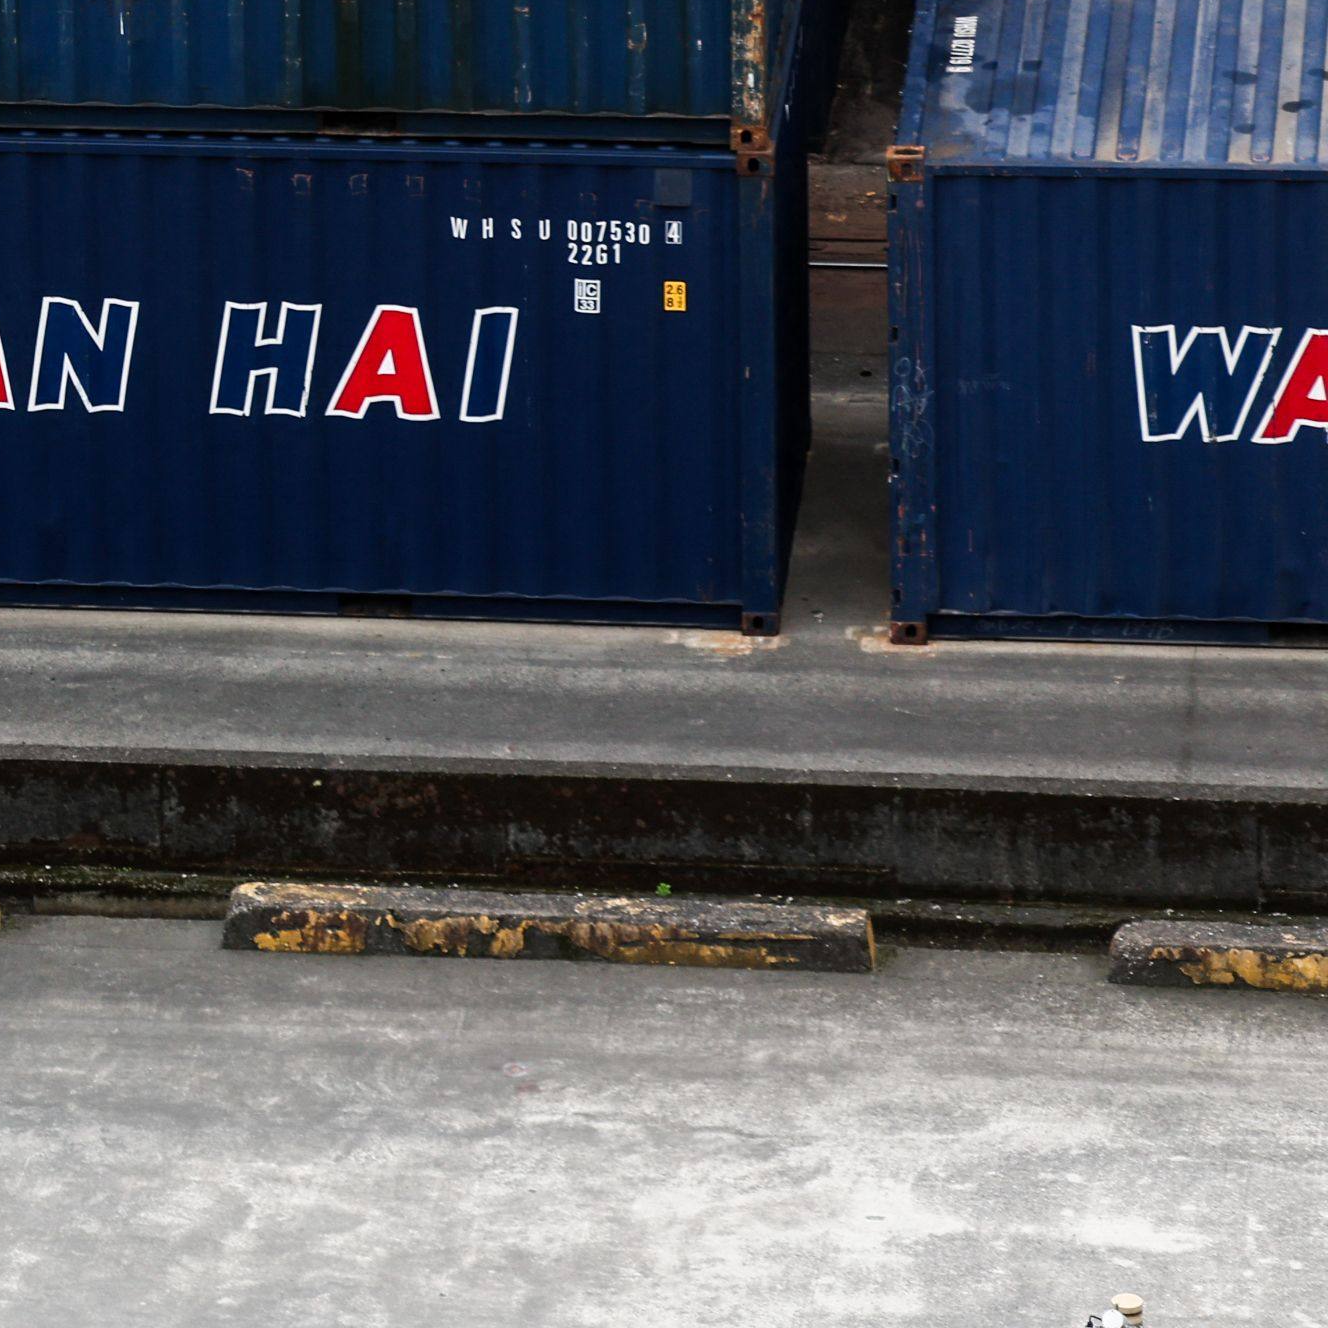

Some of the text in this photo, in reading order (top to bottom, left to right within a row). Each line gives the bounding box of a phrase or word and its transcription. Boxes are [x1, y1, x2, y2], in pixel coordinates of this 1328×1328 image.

[567, 220, 650, 245] 007530
[568, 242, 621, 266] 22G1
[578, 300, 595, 310] 33
[208, 301, 518, 422] HAI
[1131, 324, 1328, 445] WA
